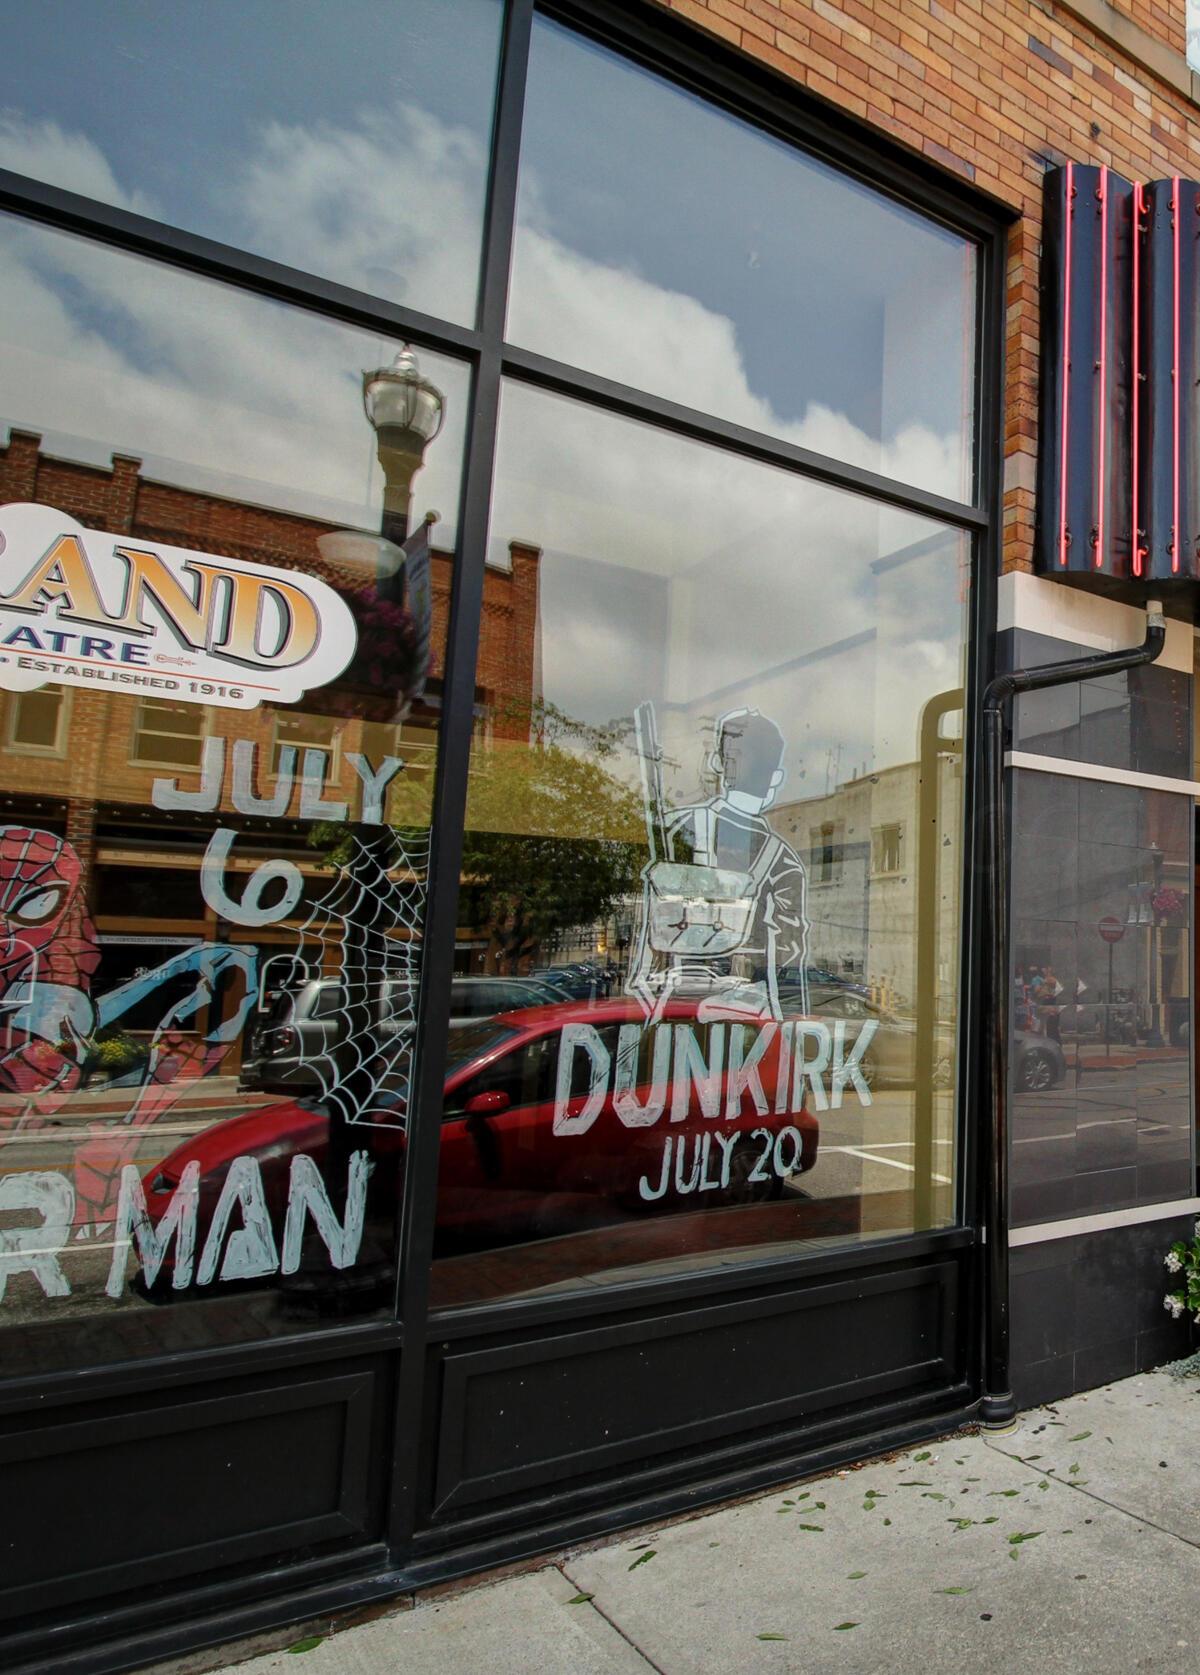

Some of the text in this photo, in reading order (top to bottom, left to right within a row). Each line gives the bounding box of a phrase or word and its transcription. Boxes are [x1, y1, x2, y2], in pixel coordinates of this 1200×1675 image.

[0, 528, 322, 672] AND
[0, 624, 152, 667] ATRE
[17, 656, 245, 700] ESTABLISHED 1916
[152, 736, 406, 825] JULY
[200, 828, 304, 926] 6
[552, 1019, 880, 1137] DUNKIRK
[639, 1124, 803, 1201] JULY 20
